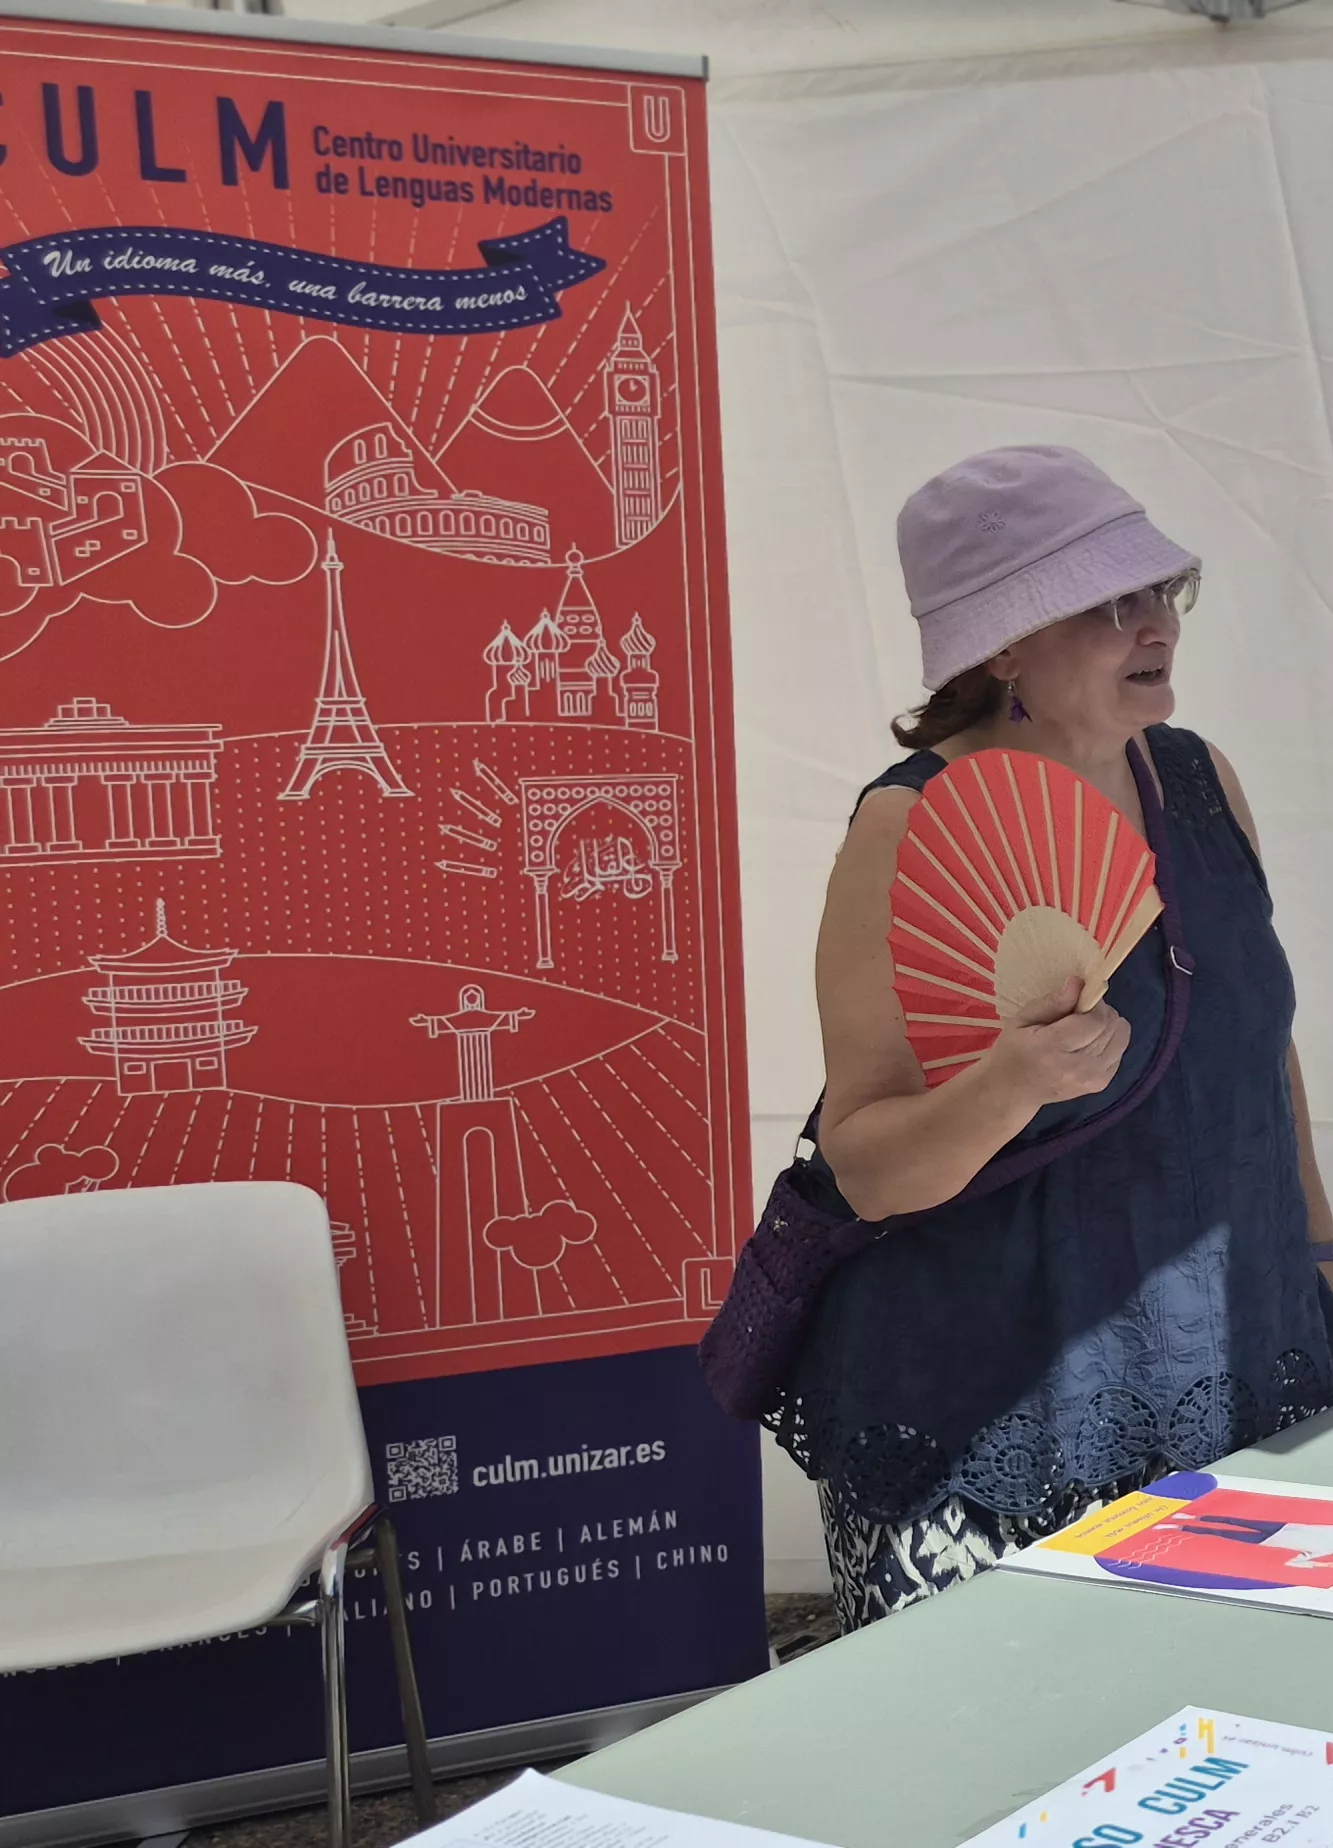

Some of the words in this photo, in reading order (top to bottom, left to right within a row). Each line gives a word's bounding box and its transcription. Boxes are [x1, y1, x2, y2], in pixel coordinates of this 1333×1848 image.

[0, 81, 290, 190] ULM
[313, 125, 402, 162] Centro
[413, 134, 582, 175] Universitario
[316, 164, 349, 195] de
[358, 166, 474, 209] Lenguas
[484, 175, 613, 212] Modernas
[43, 250, 93, 278] Un
[104, 248, 196, 274] idioma
[289, 279, 336, 300] una
[348, 281, 444, 312] barrera
[456, 285, 528, 310] menos
[472, 1440, 666, 1487] culm.unizar.es
[460, 1531, 541, 1562] ÁRABE
[579, 1509, 677, 1544] ALEMÁN
[472, 1558, 620, 1600] PORTUGUÉS
[656, 1544, 729, 1570] CHINO
[1137, 1756, 1250, 1816] CULM
